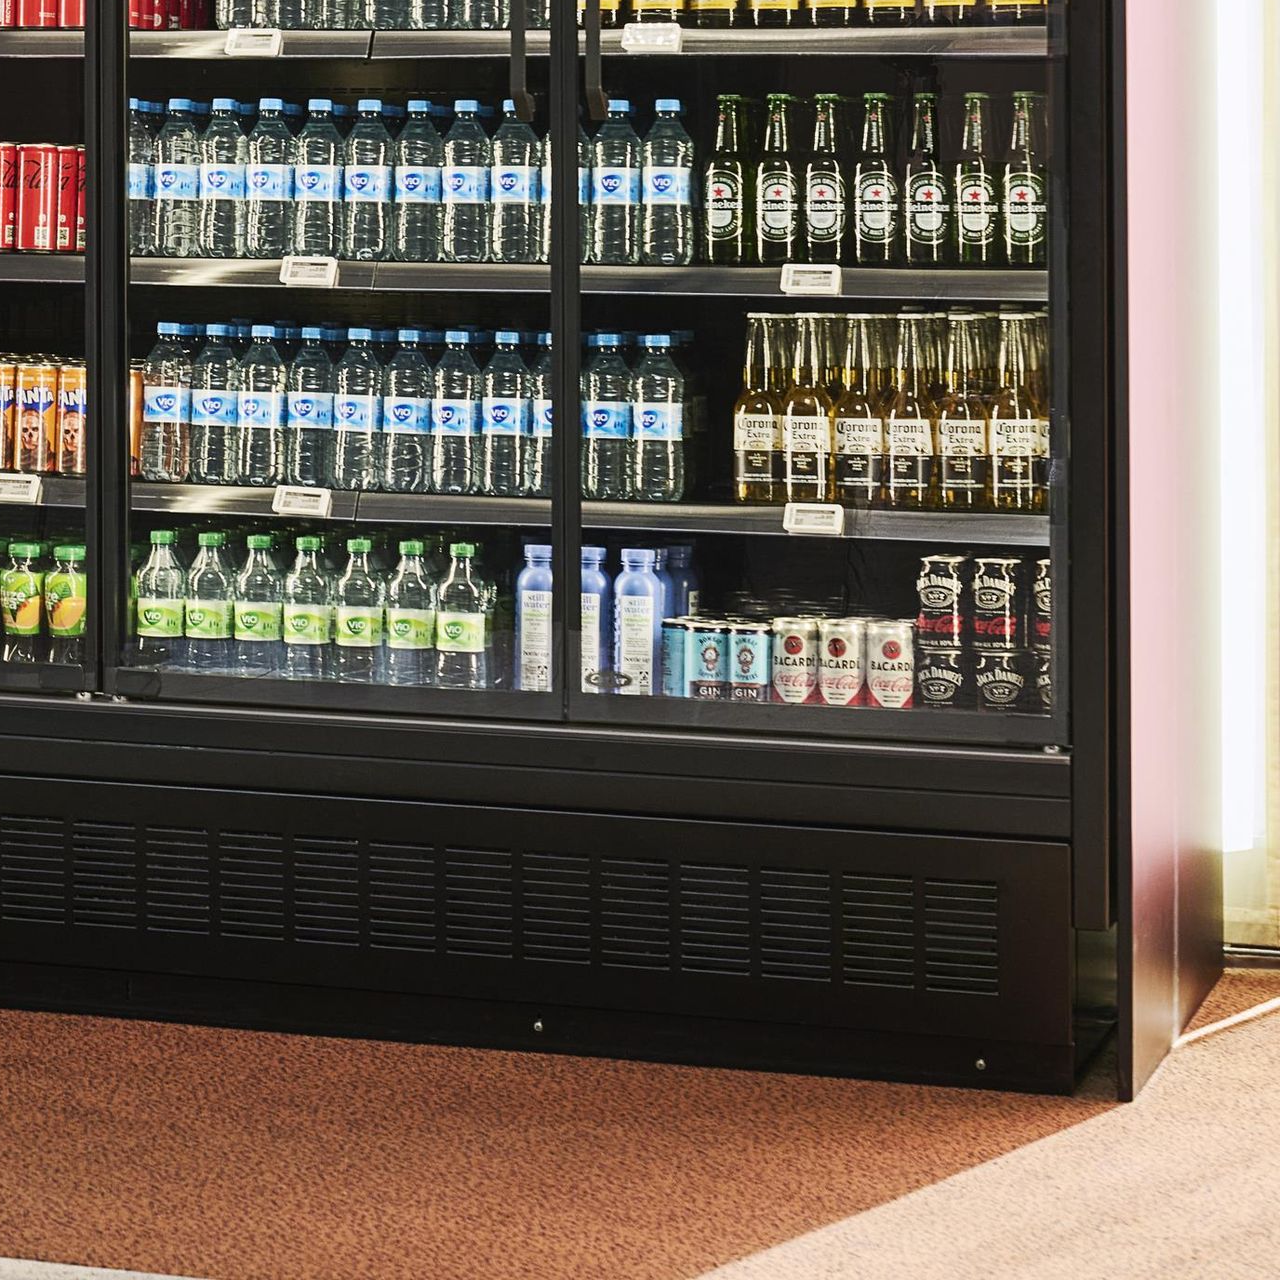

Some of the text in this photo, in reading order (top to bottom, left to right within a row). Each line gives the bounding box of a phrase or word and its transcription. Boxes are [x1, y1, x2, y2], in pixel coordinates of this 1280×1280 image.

[836, 421, 878, 434] Corona
[939, 422, 982, 434] Corona
[996, 422, 1036, 434] Corona
[699, 686, 720, 696] GIN
[735, 688, 757, 698] GIN
